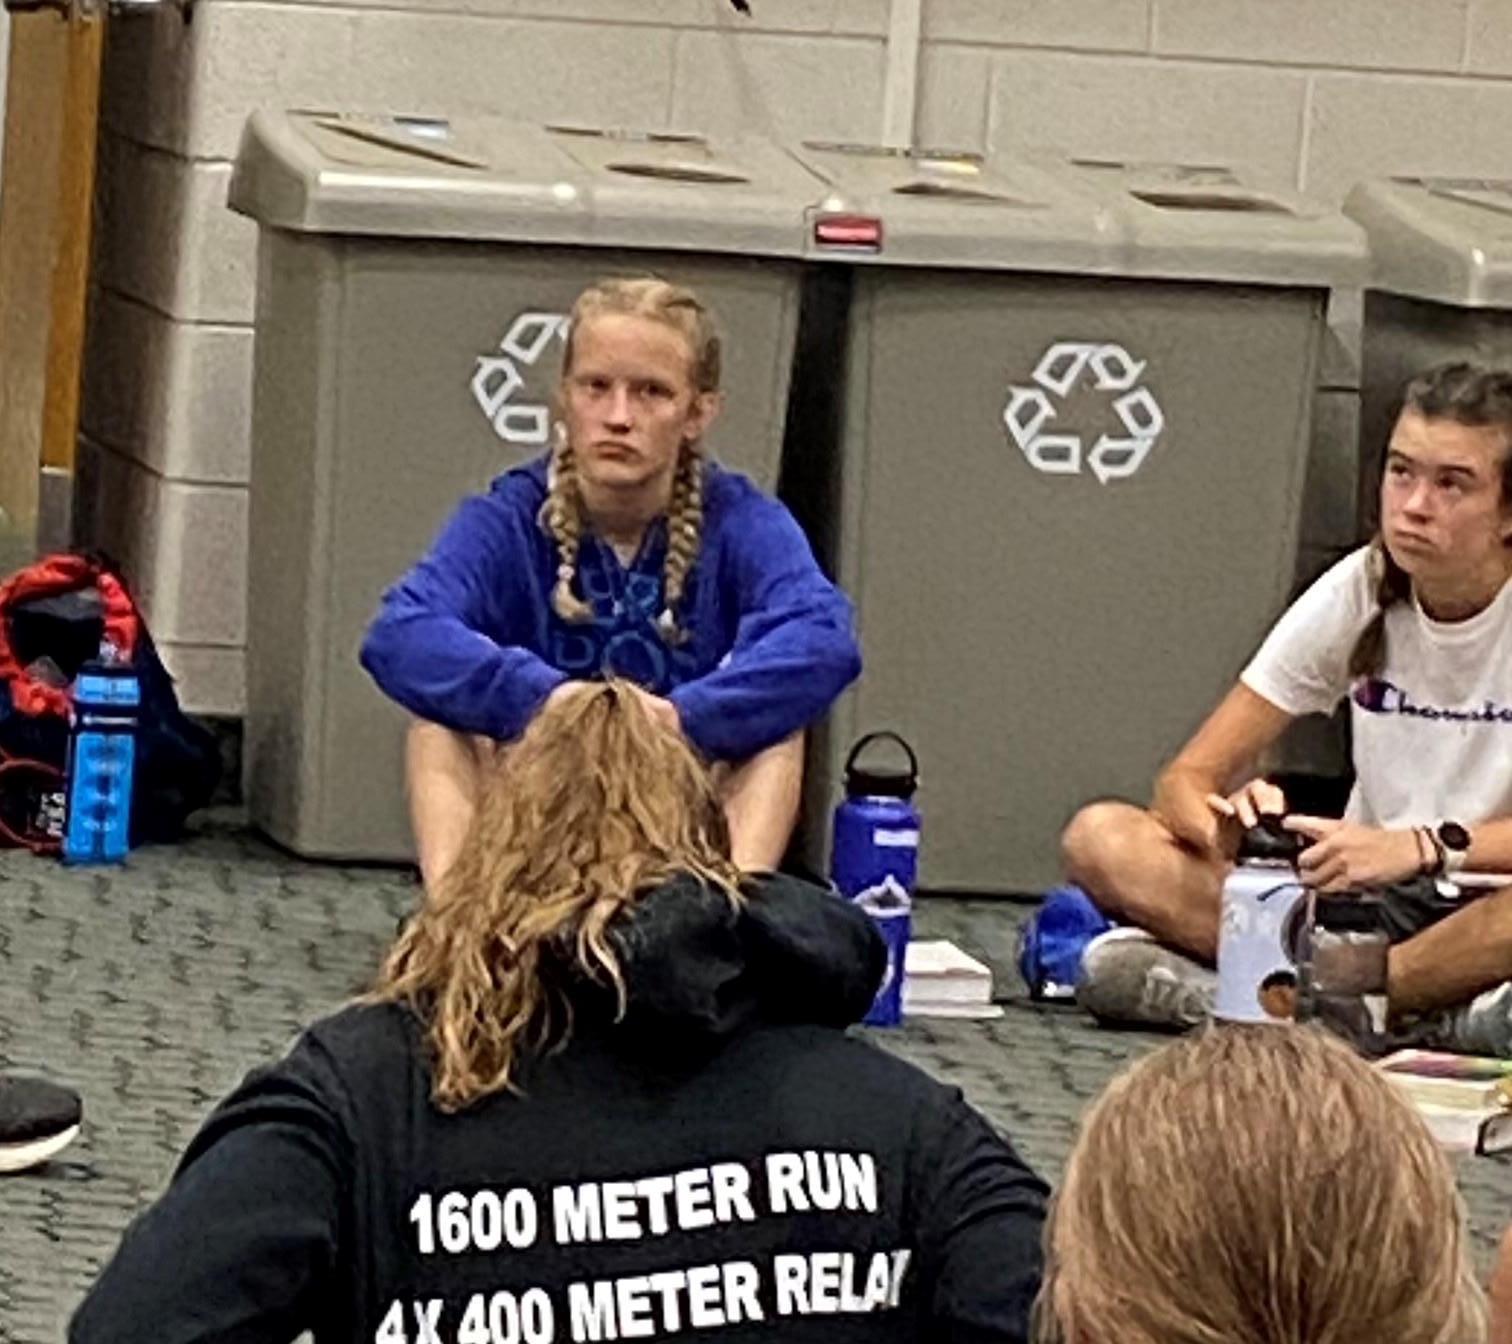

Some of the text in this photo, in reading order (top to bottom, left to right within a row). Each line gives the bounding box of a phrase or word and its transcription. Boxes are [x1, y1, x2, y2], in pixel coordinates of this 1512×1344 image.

[409, 1151, 878, 1254] 1600 METER RUN
[568, 1261, 764, 1344] METER
